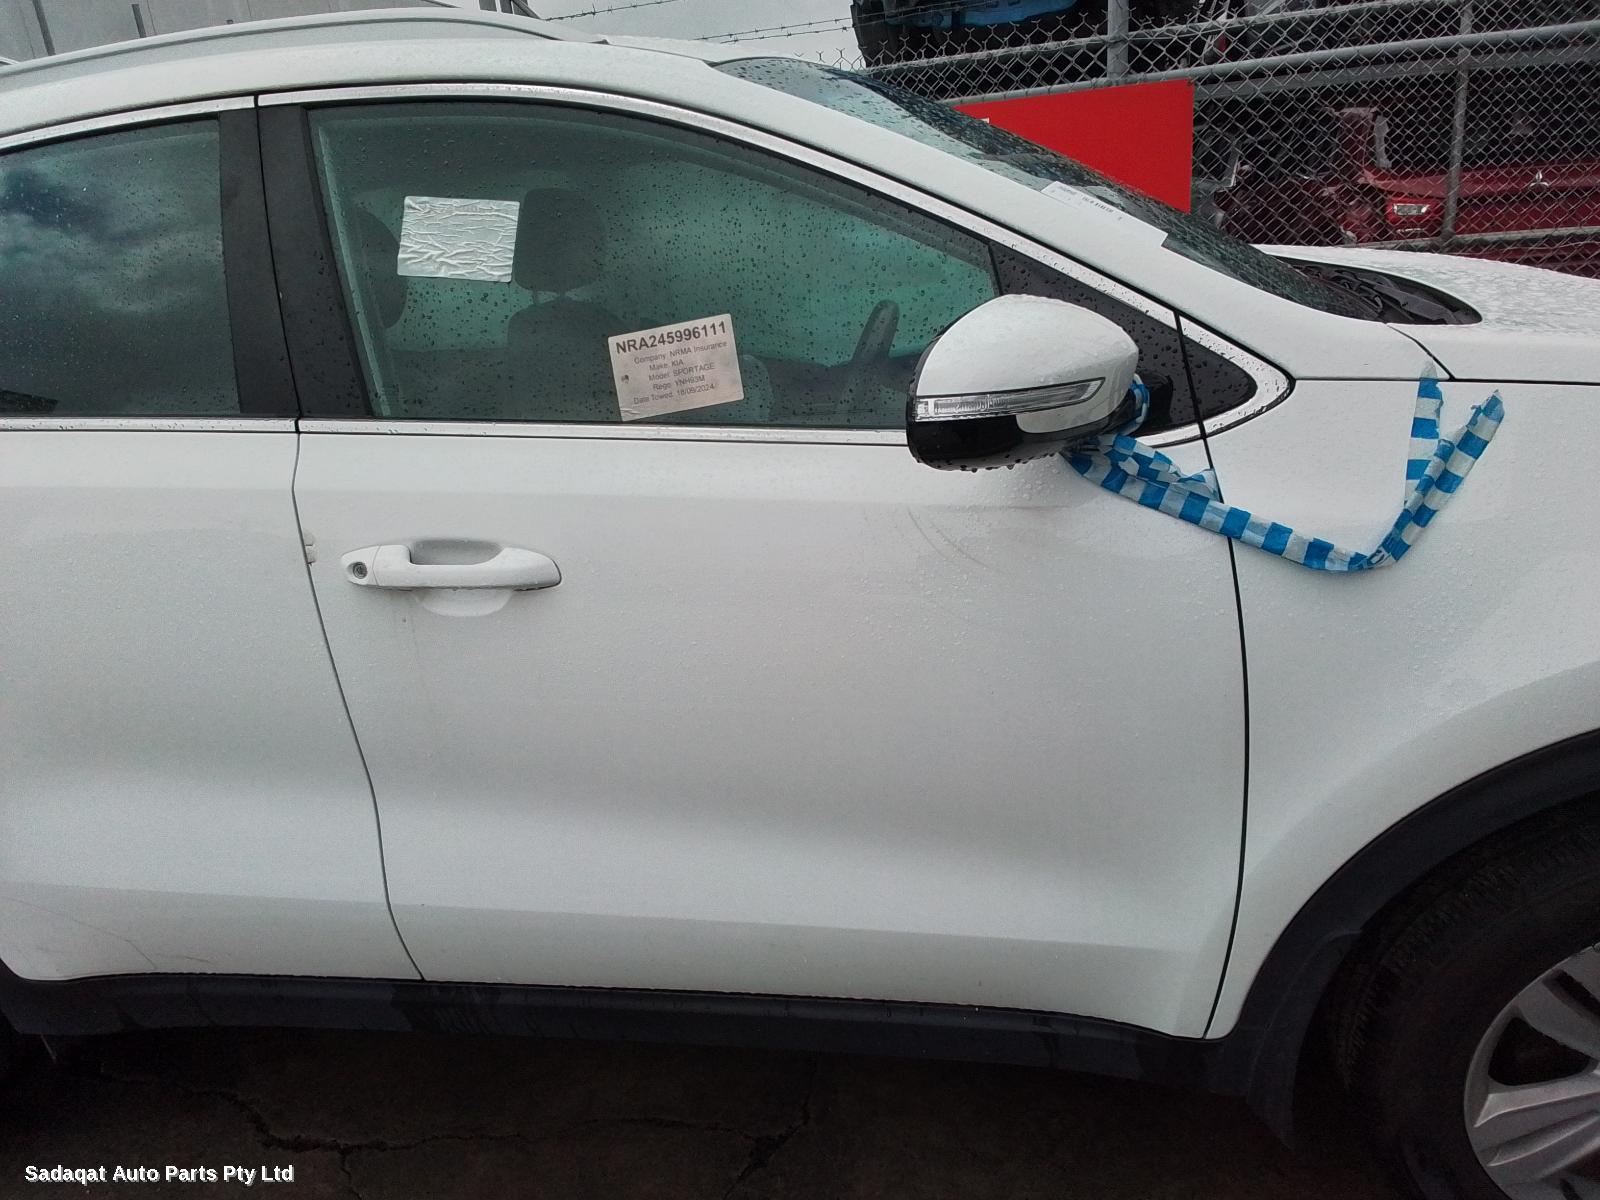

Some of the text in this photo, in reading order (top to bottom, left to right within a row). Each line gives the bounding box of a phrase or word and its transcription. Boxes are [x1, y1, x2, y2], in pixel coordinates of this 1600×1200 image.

[616, 321, 726, 354] NRA245996111
[669, 347, 692, 358] NRMA
[693, 341, 728, 353] Insurance
[671, 359, 684, 367] KIA
[673, 362, 716, 377] SPORTAGE
[633, 395, 650, 405] Date
